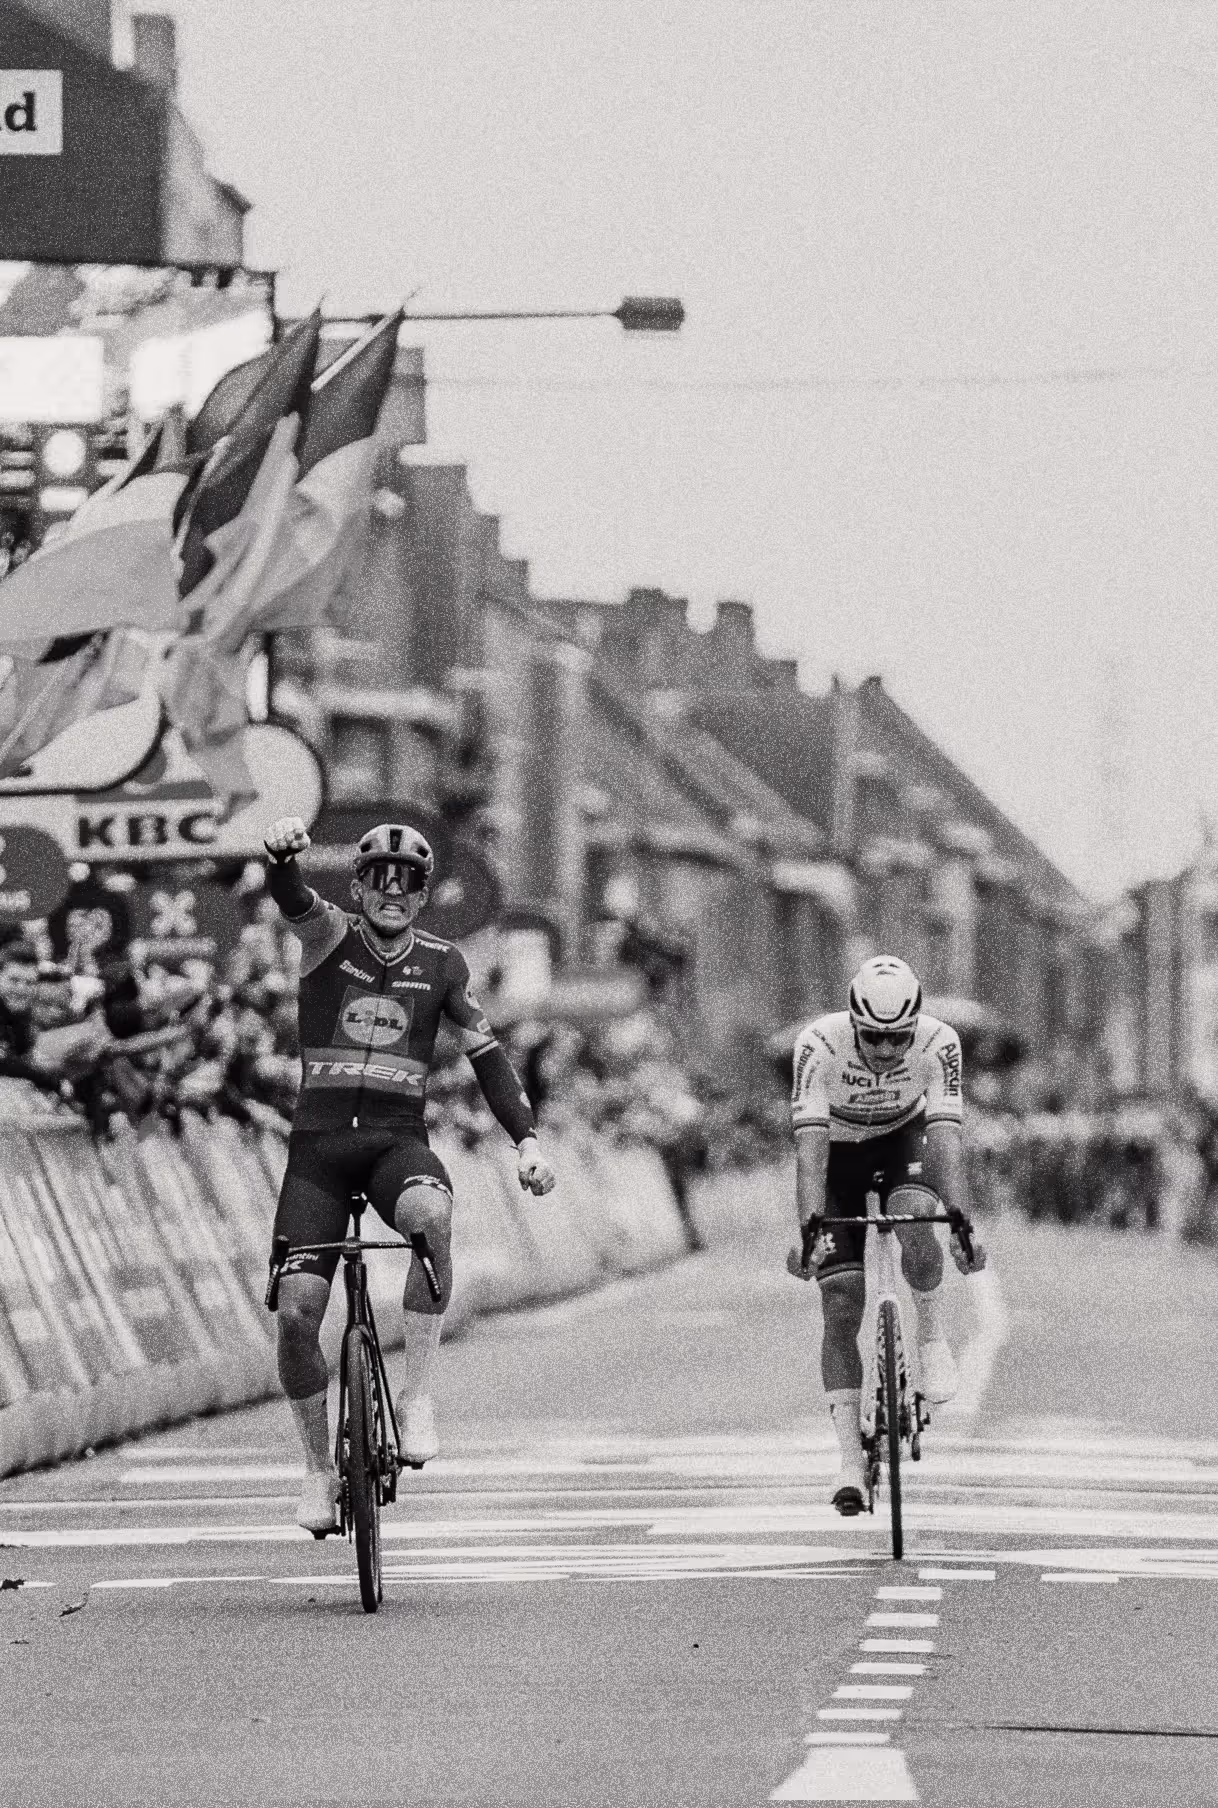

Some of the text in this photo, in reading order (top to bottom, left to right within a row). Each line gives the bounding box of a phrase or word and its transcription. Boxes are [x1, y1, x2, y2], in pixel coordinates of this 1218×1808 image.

[0, 91, 37, 131] d
[78, 811, 217, 848] KBC
[339, 960, 375, 983] Santini
[309, 1062, 423, 1086] TREK
